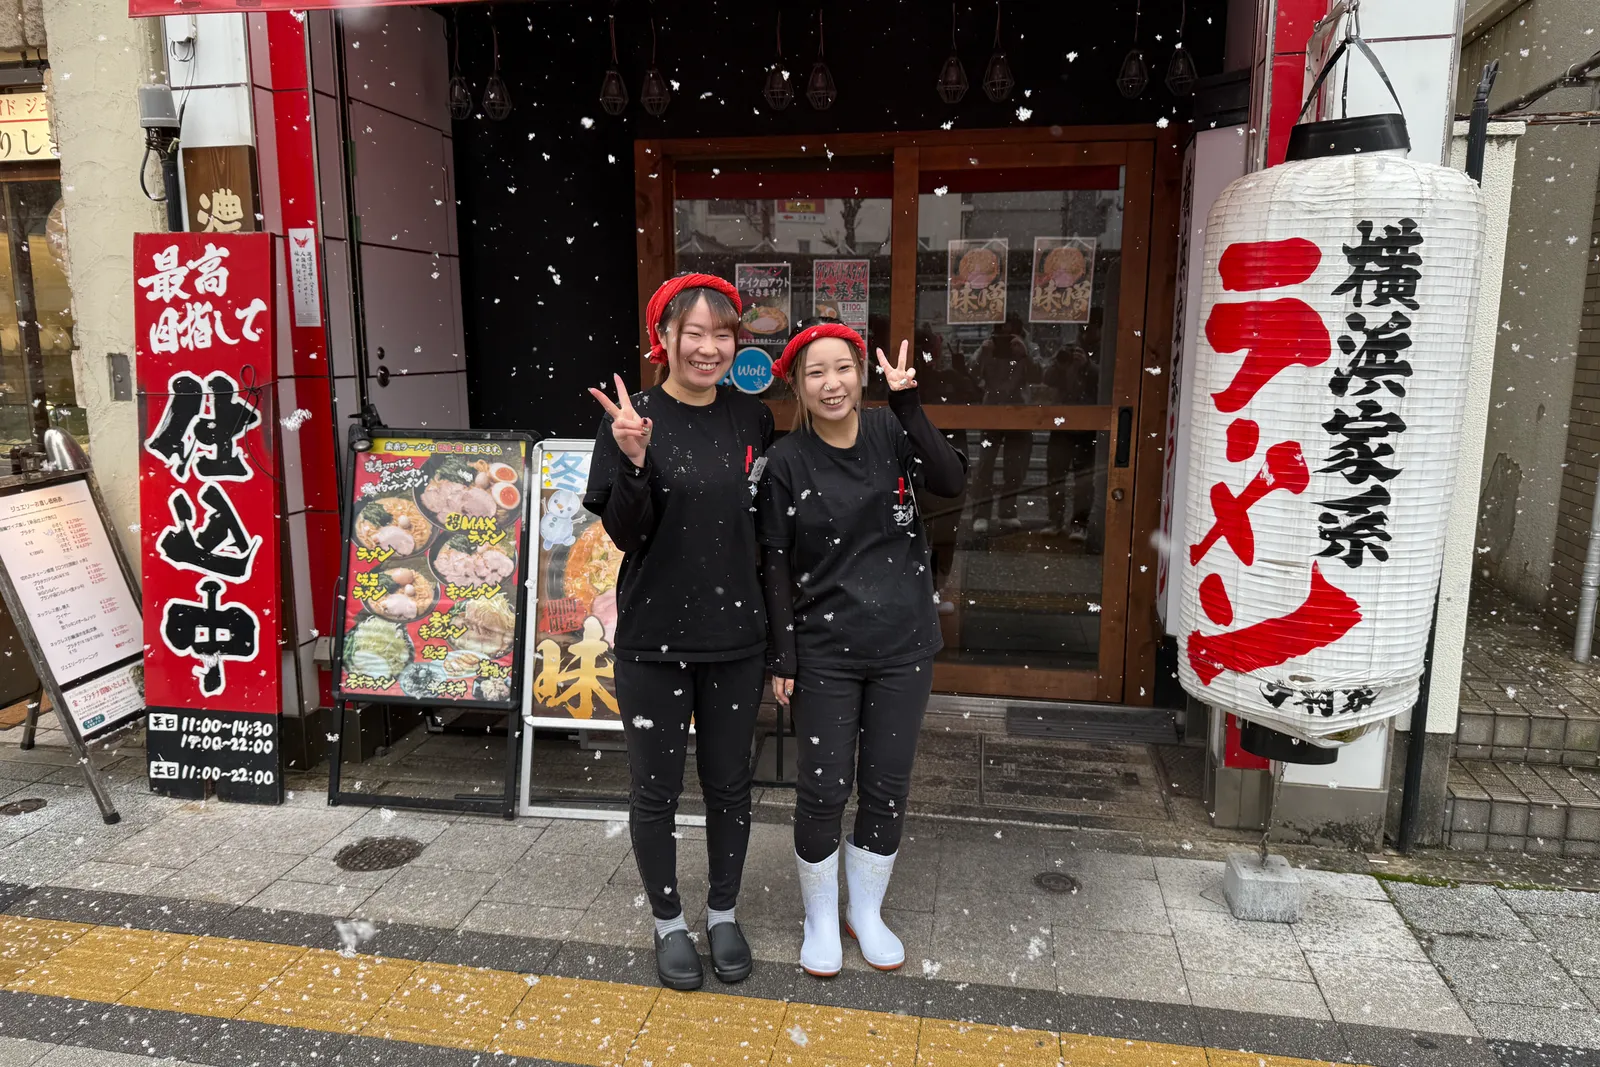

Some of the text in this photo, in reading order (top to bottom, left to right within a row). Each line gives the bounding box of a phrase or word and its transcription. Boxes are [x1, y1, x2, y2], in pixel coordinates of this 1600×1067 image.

[138, 242, 230, 303] 最高
[816, 281, 866, 300] 大募集
[150, 298, 267, 355] 目指して
[737, 364, 767, 377] Wolt
[1312, 218, 1424, 568] 横浜家系
[1188, 237, 1363, 686] ラーメン
[551, 451, 588, 493] 冬
[144, 370, 262, 697] 仕込中
[467, 529, 507, 547] ラーメン
[356, 545, 395, 563] ラーメン
[352, 584, 388, 601] ラーメン
[422, 645, 448, 660] 餃子
[476, 659, 513, 679] 唐揚げ
[346, 672, 397, 691] ネギラーメン
[152, 715, 175, 729] 平日
[153, 763, 177, 776] 土日
